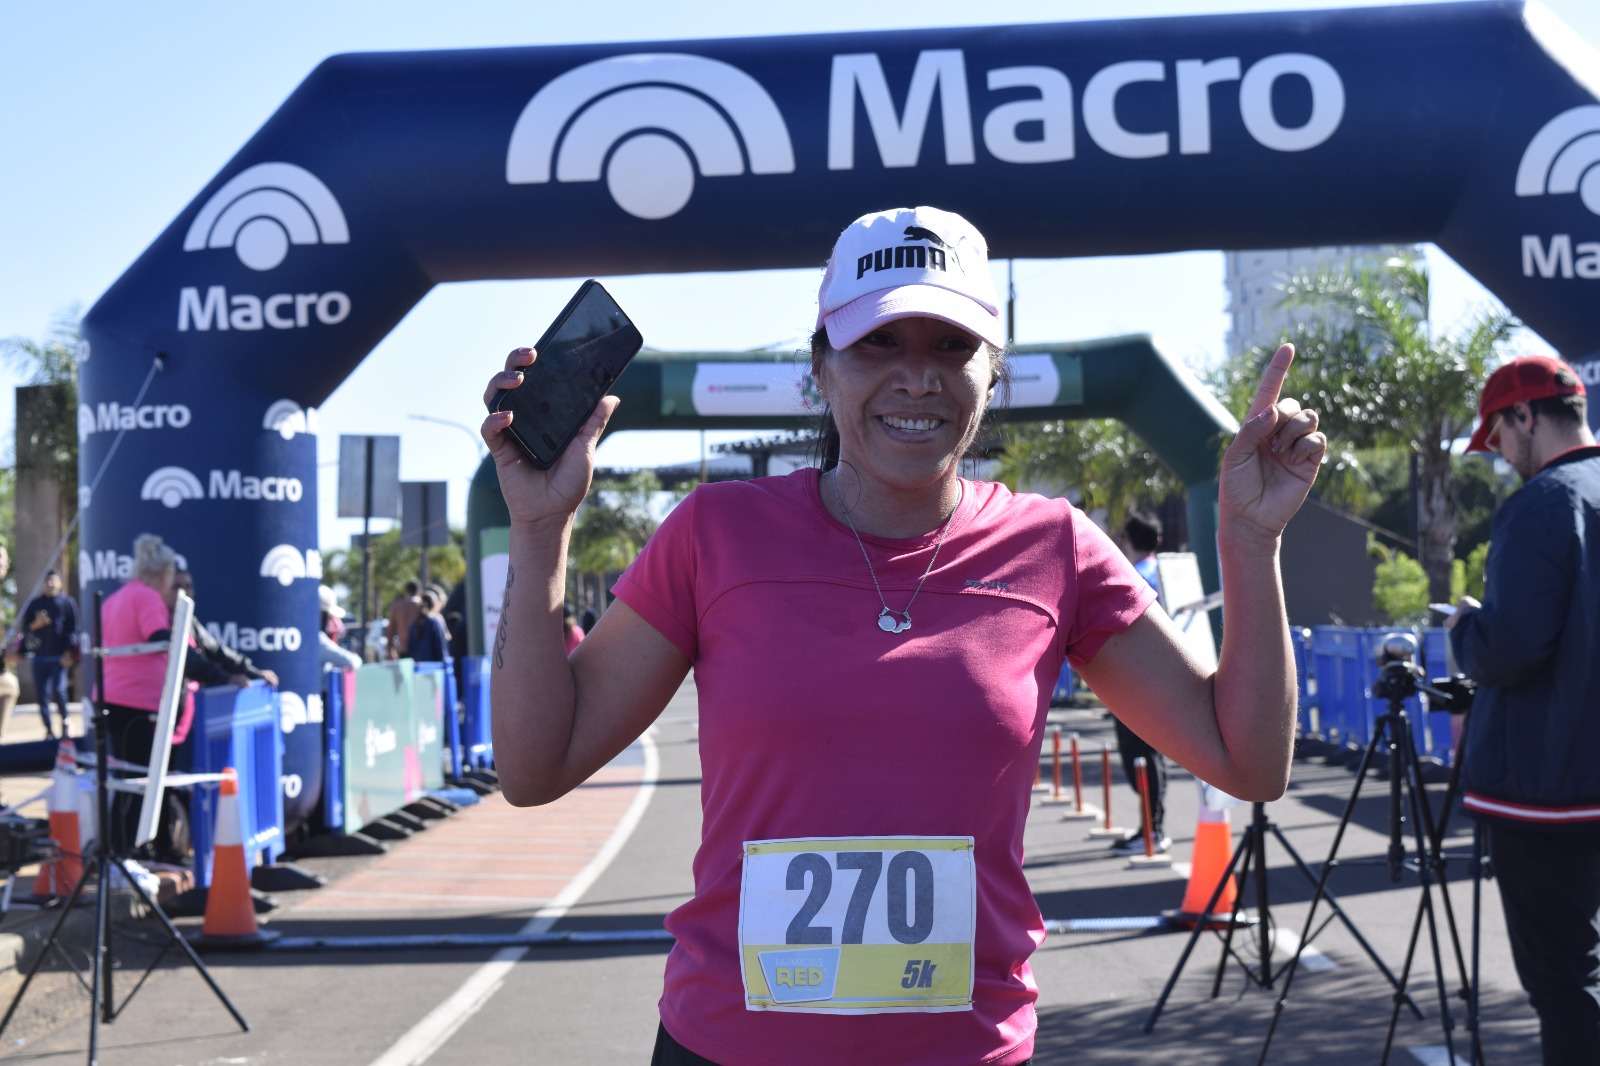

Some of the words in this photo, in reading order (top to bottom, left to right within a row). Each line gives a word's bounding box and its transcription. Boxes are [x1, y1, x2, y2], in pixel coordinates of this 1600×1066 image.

[827, 49, 1346, 170] Macro
[856, 245, 947, 280] PUMA
[177, 285, 351, 332] Macro
[96, 401, 192, 432] Macro
[208, 469, 303, 503] Macro
[205, 622, 302, 652] Macro
[785, 850, 935, 945] 270
[776, 967, 825, 988] RED
[901, 959, 938, 989] 5k
